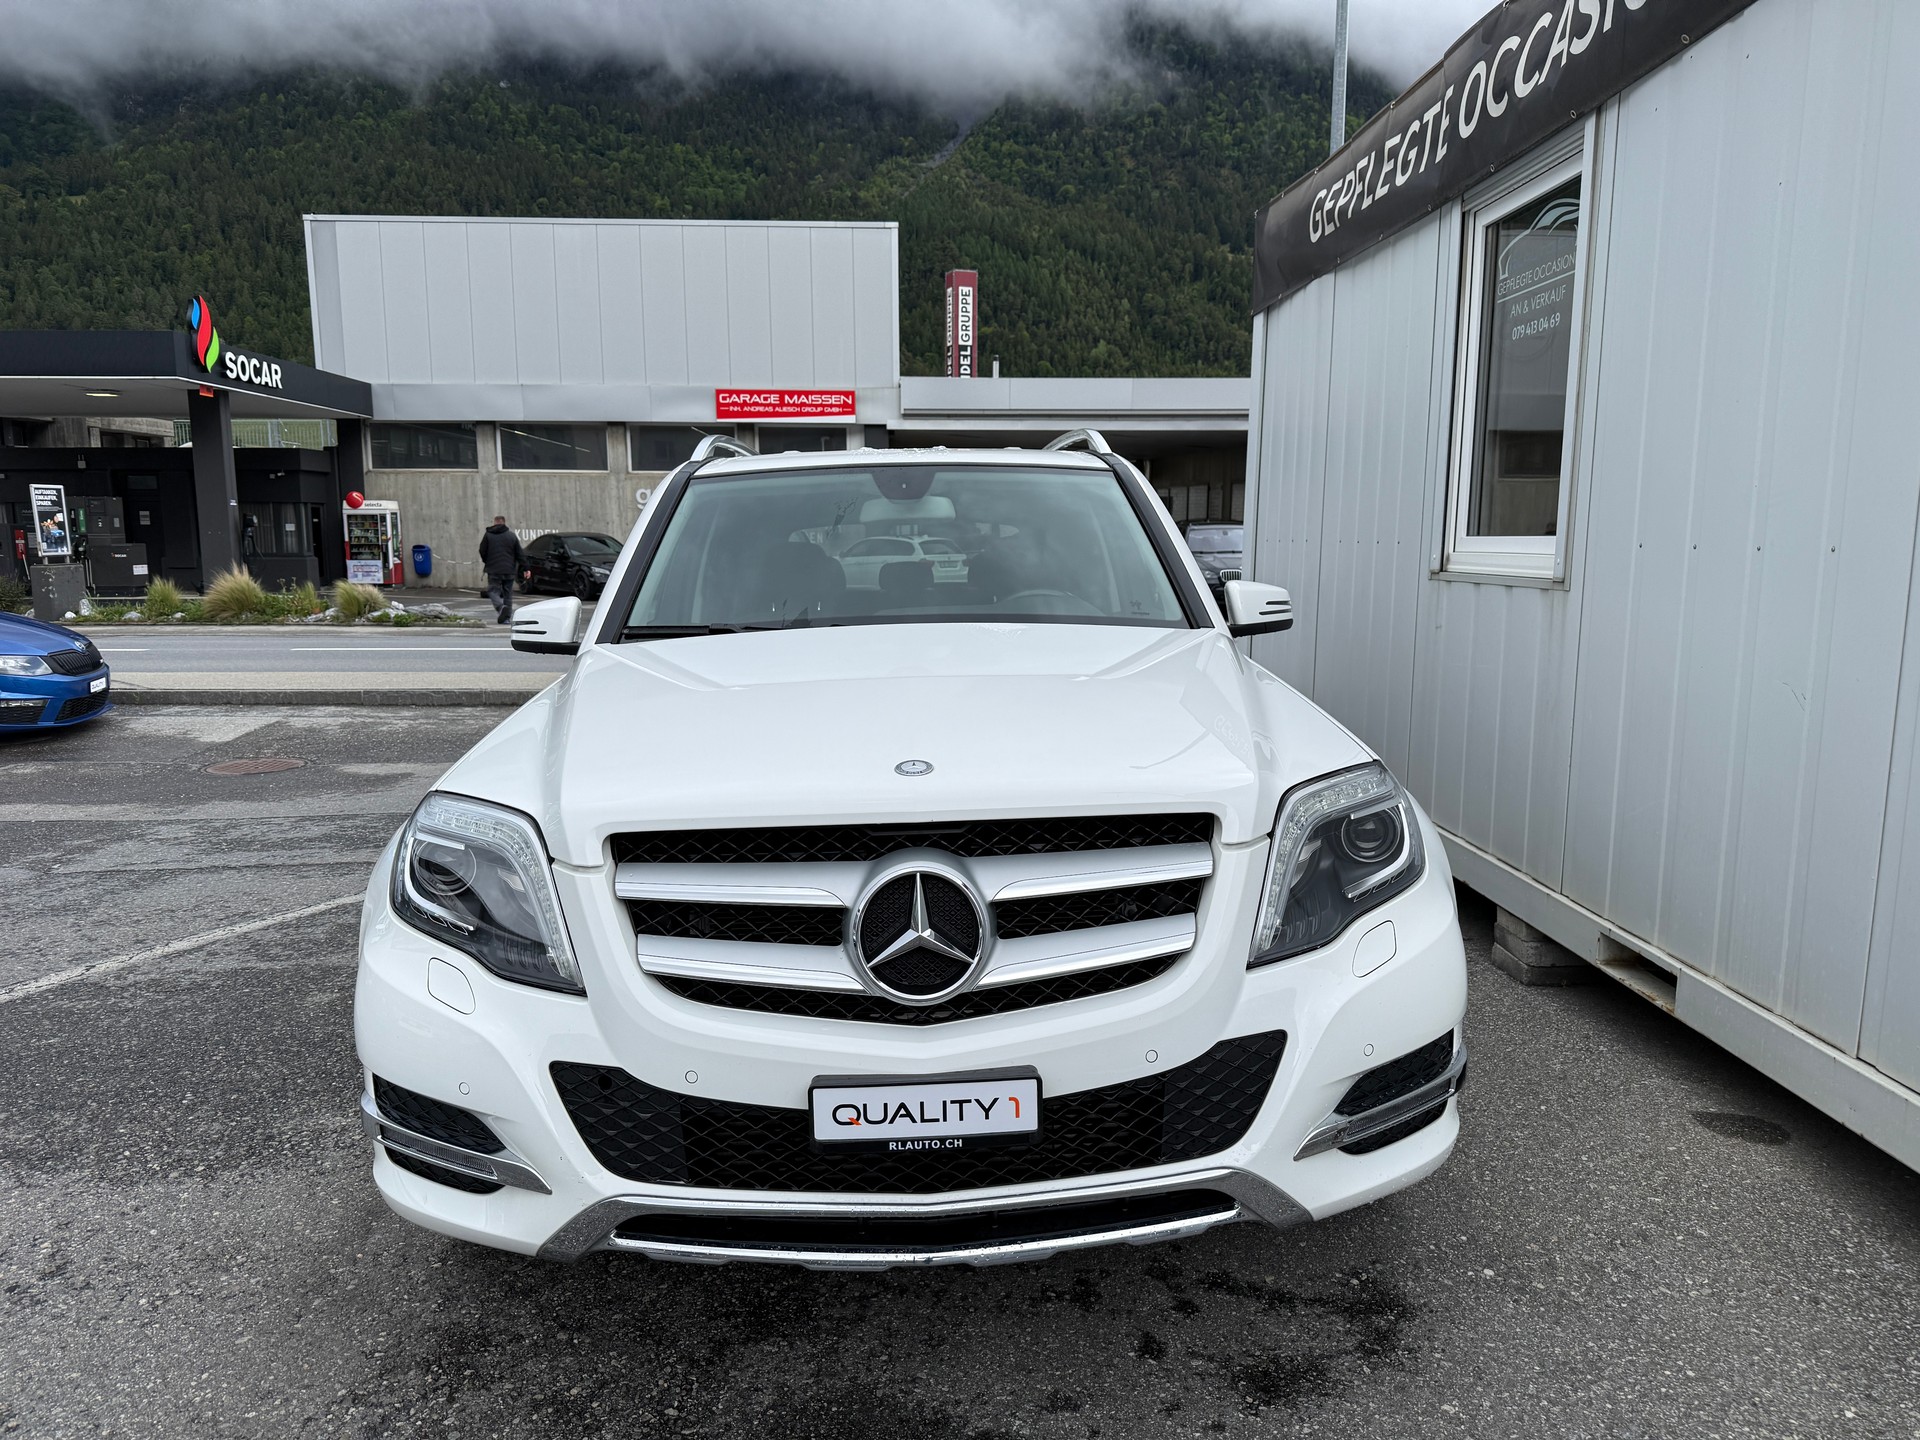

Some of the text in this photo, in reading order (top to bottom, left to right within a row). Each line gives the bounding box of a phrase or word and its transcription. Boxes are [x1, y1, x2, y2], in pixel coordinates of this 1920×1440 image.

[1309, 0, 1647, 243] GEPFLEGTE OCCAS
[1497, 270, 1533, 296] GEPFLEGTE
[960, 289, 971, 342] GRUPPE
[1510, 303, 1521, 318] AN
[1530, 284, 1567, 310] VERKAUF
[1512, 312, 1561, 340] 079 413 04 69
[225, 351, 283, 389] SOCAR
[719, 393, 852, 405] GARAGE MAISSEN
[831, 1097, 1000, 1126] QUALITY
[889, 1138, 963, 1150] RLAUTO.CH
